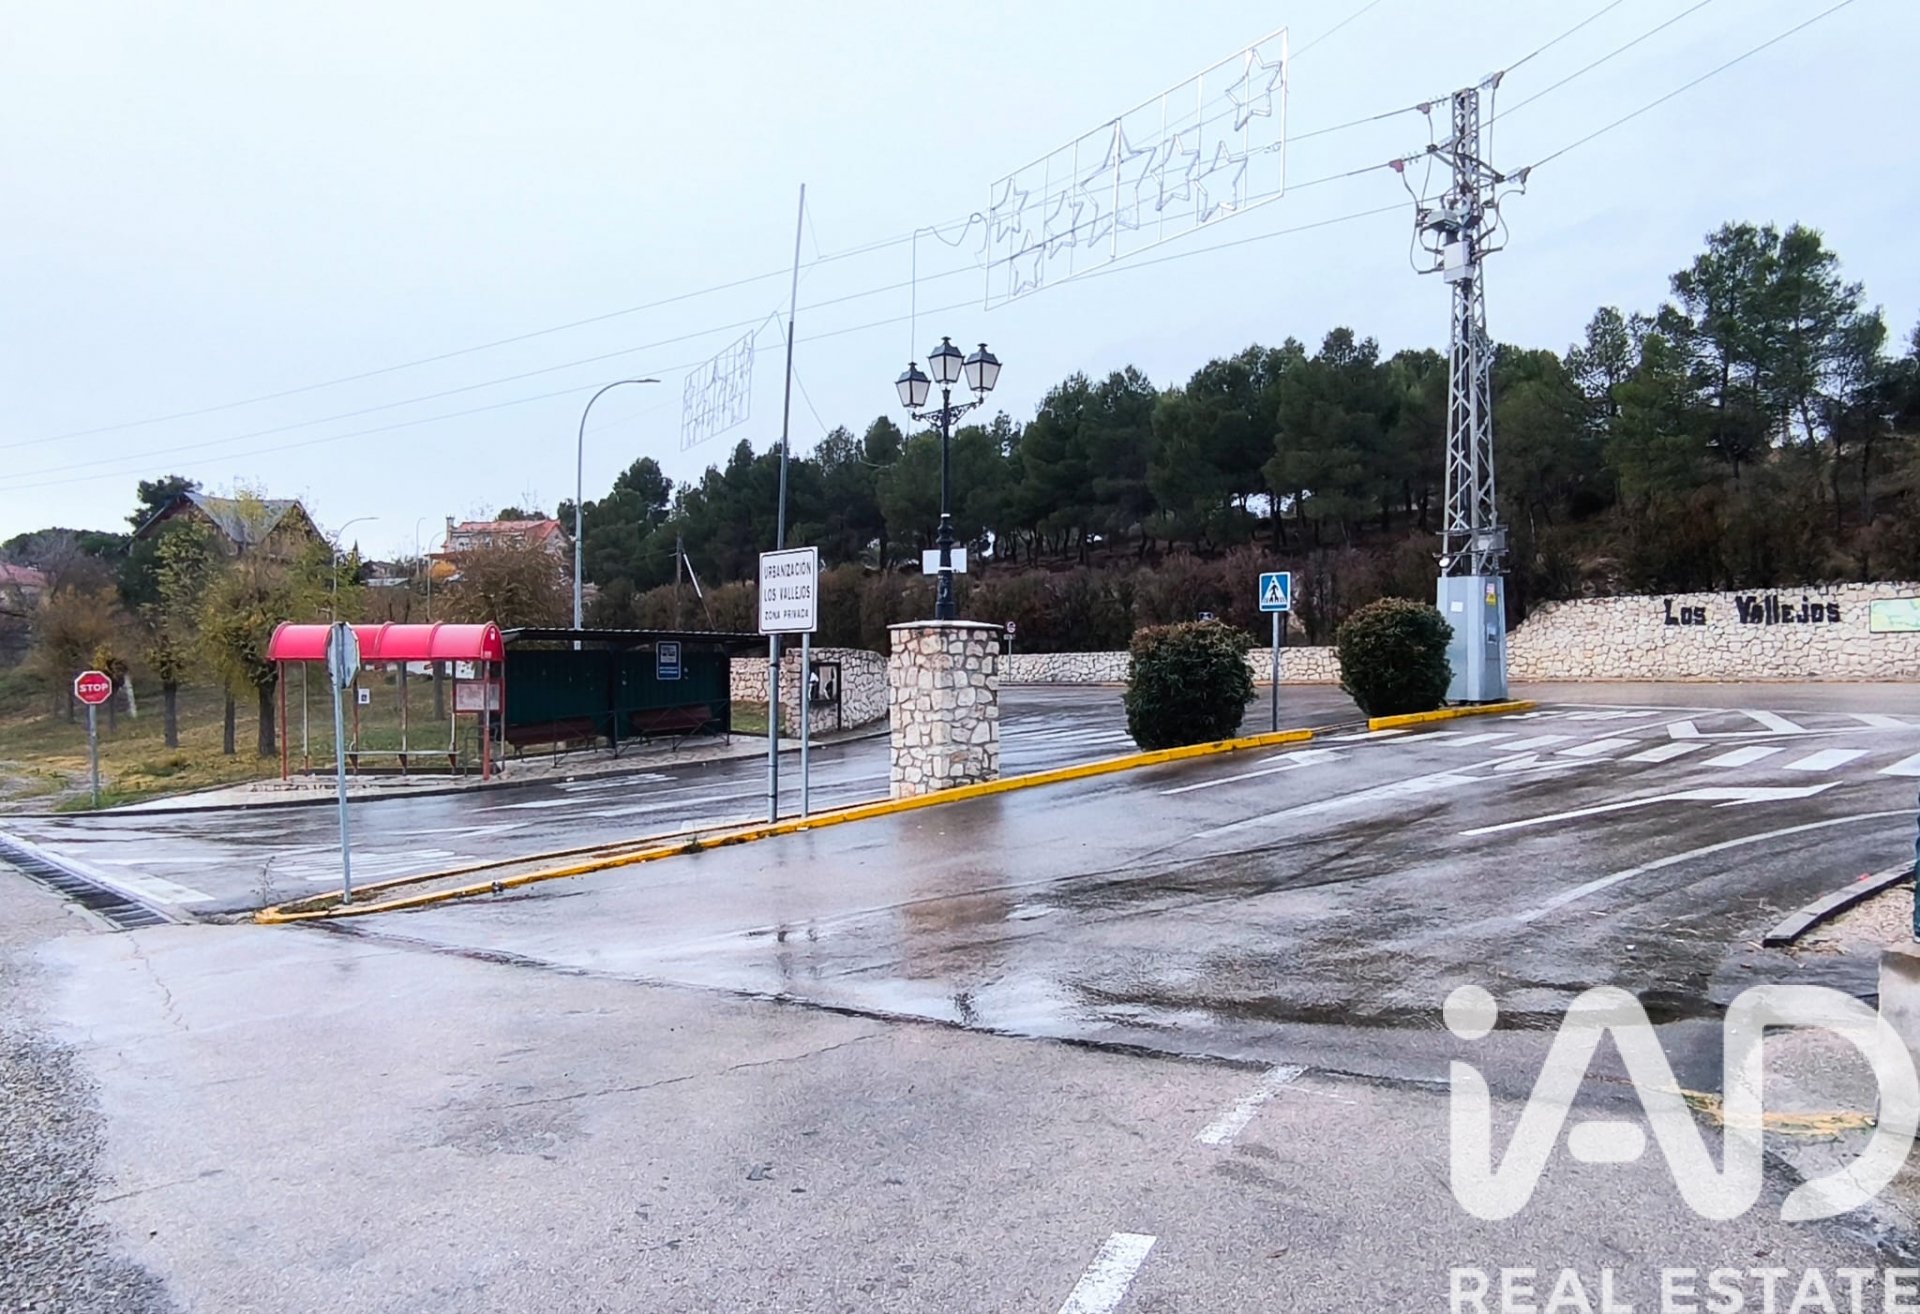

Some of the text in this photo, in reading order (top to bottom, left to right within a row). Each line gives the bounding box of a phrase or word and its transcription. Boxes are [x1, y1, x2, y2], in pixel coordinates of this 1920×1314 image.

[764, 585, 810, 602] LOS VALLEJOS
[765, 608, 808, 621] ZONA PRIVADA
[79, 681, 108, 693] STOP
